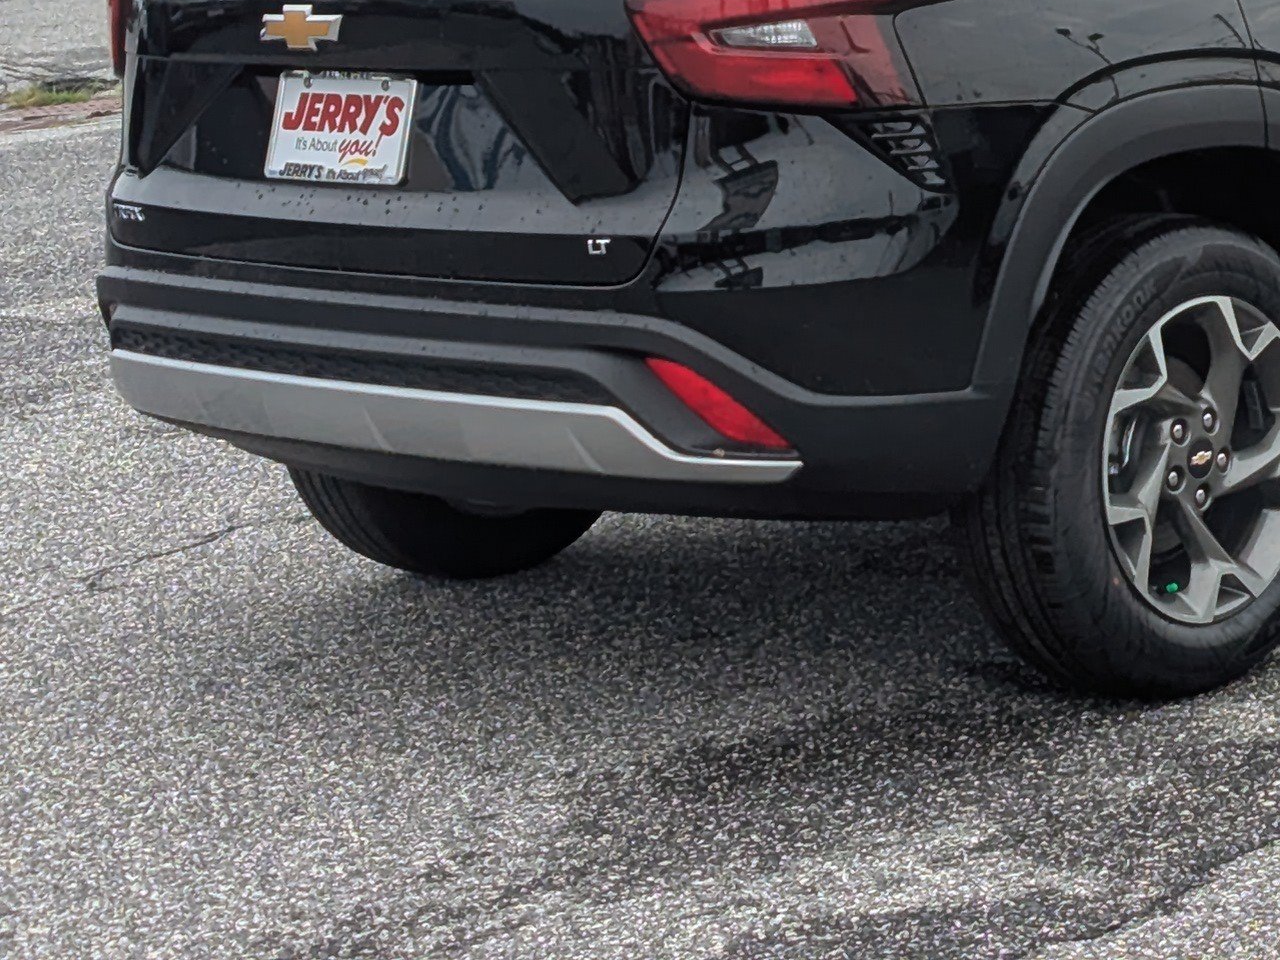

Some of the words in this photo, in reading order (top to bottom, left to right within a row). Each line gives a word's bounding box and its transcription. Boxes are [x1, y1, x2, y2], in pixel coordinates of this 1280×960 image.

[282, 92, 405, 137] JERRY'S
[295, 136, 308, 151] It's
[308, 136, 338, 152] About
[338, 135, 383, 164] you!
[278, 161, 324, 179] JERRY'S
[587, 239, 612, 256] LT
